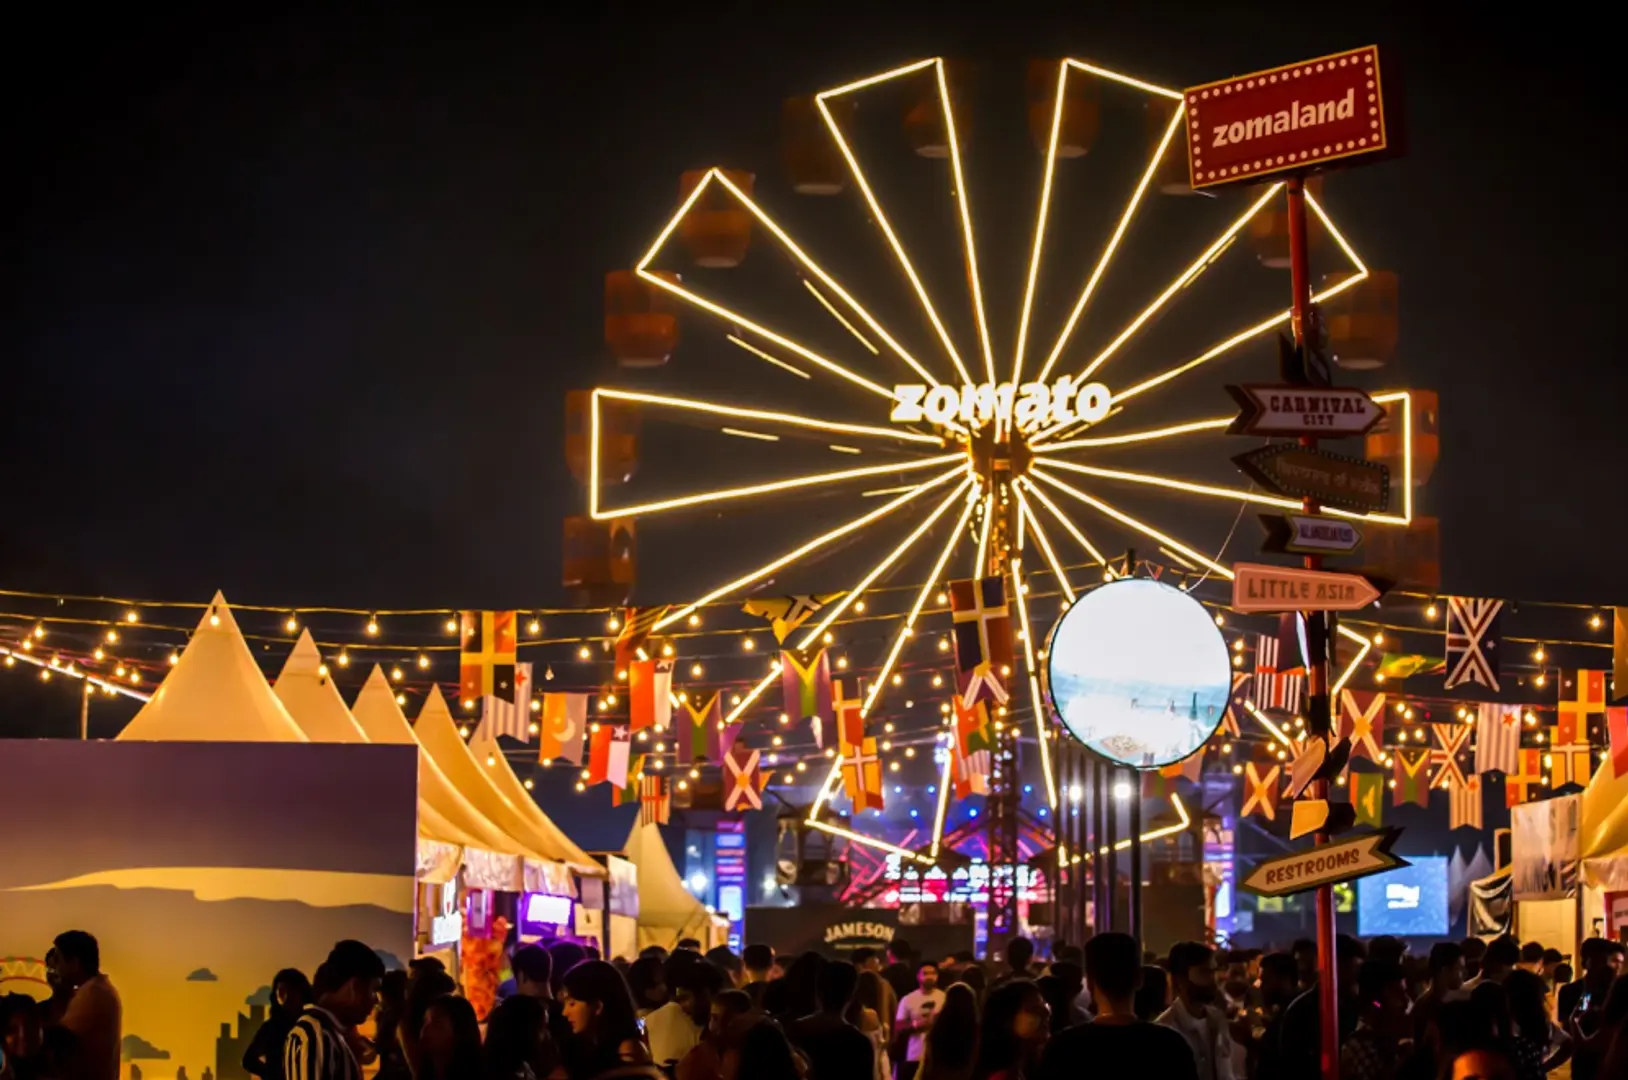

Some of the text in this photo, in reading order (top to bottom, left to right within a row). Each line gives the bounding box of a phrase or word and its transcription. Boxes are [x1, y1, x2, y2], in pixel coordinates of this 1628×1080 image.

[1212, 88, 1354, 148] zomaland
[890, 375, 1112, 424] zomato
[1270, 395, 1365, 414] CARNIVAL
[1302, 414, 1334, 426] CITY
[1247, 577, 1356, 600] LITTLE ASIA
[1265, 848, 1360, 885] RESTROOMS
[824, 921, 896, 943] JAMESON
